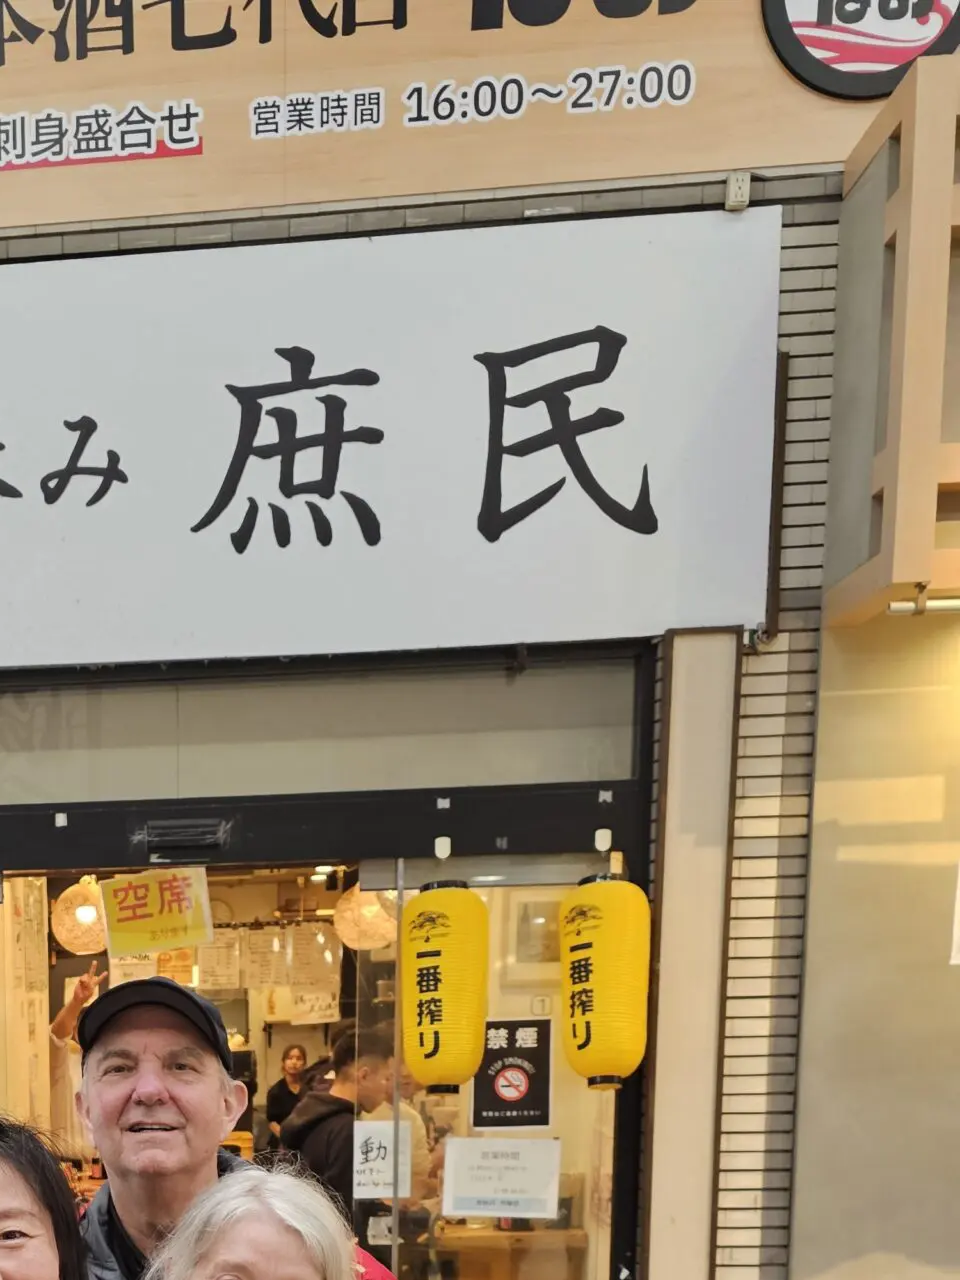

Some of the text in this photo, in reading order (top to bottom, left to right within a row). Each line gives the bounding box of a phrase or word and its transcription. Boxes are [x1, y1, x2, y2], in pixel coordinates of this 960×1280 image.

[252, 89, 382, 136] 営業時間
[190, 325, 658, 555] 庶民
[112, 874, 193, 924] 空席
[415, 948, 443, 1060] 一番搾り
[569, 941, 594, 1051] 一番搾り
[487, 1027, 538, 1050] 禁煙
